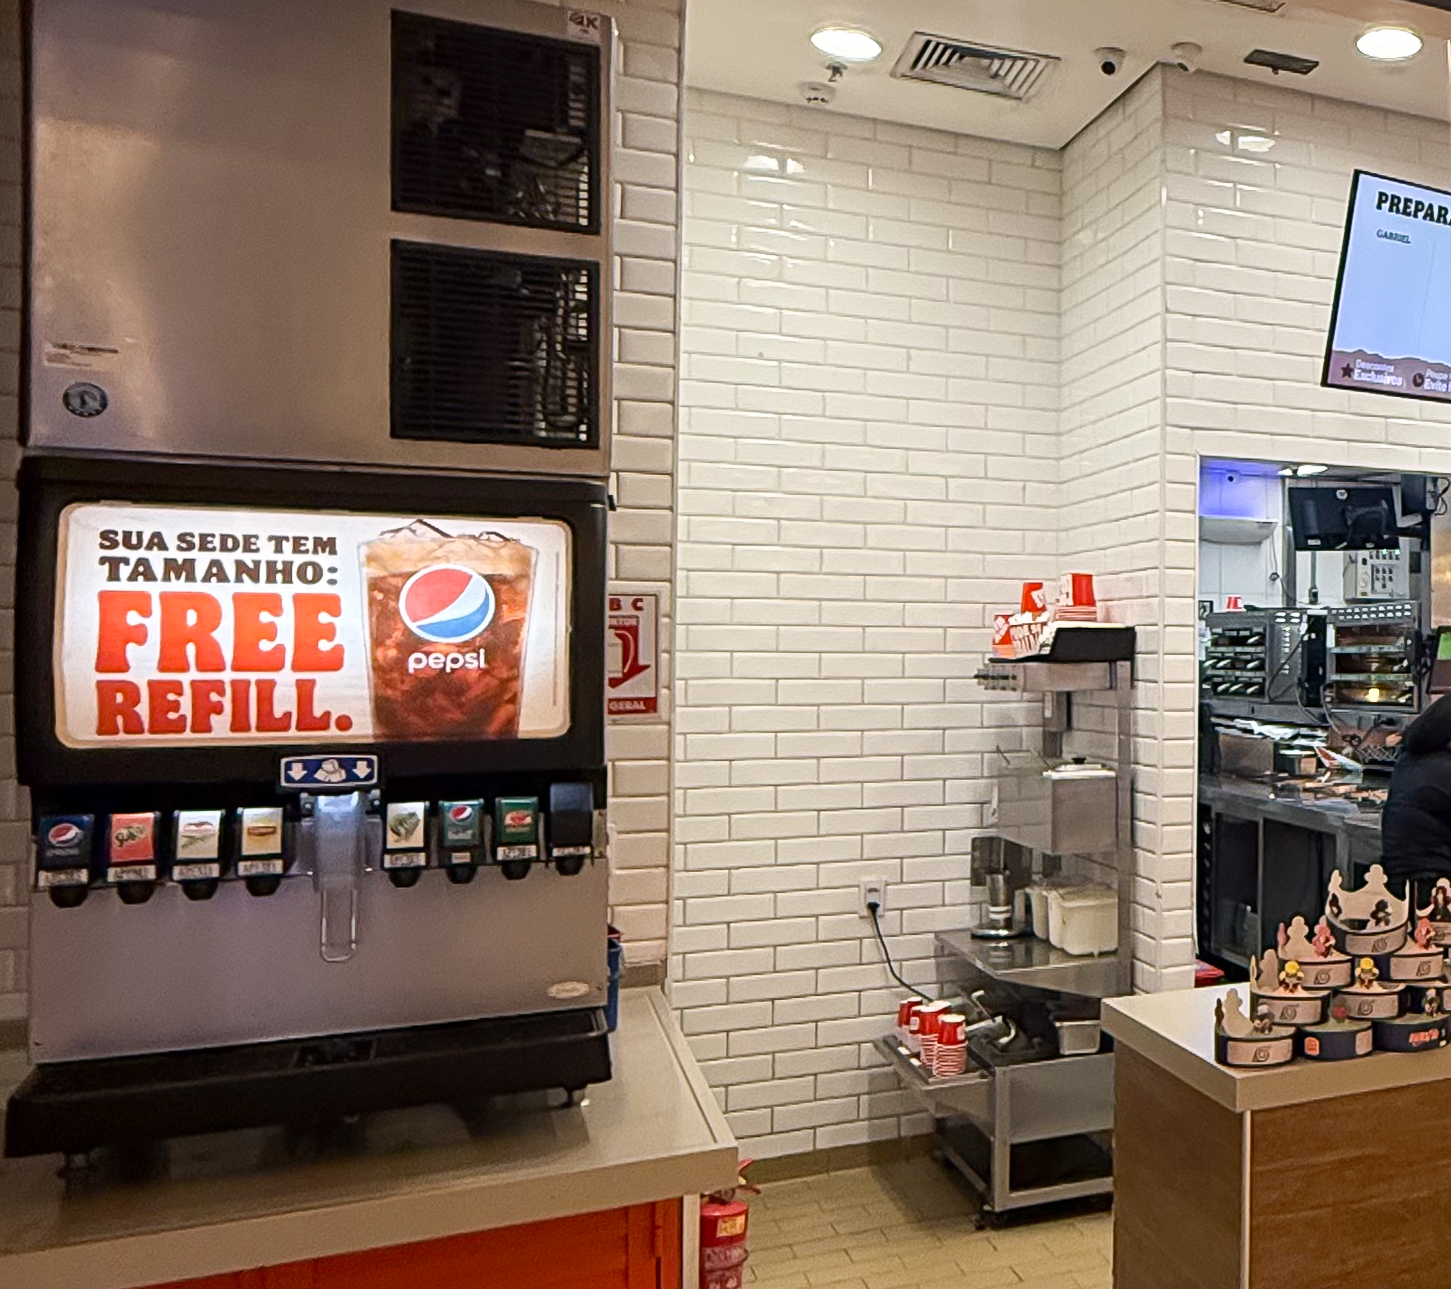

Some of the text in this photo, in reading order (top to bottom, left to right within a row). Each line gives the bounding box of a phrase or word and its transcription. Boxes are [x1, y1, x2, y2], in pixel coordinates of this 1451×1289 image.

[1376, 228, 1412, 245] GABRIEL
[98, 529, 338, 555] SUA SEDE TEM
[98, 556, 339, 586] TAMANHO:
[631, 598, 644, 611] C
[95, 590, 345, 673] FREE
[408, 648, 487, 673] pepsi
[96, 679, 353, 736] REFILL.
